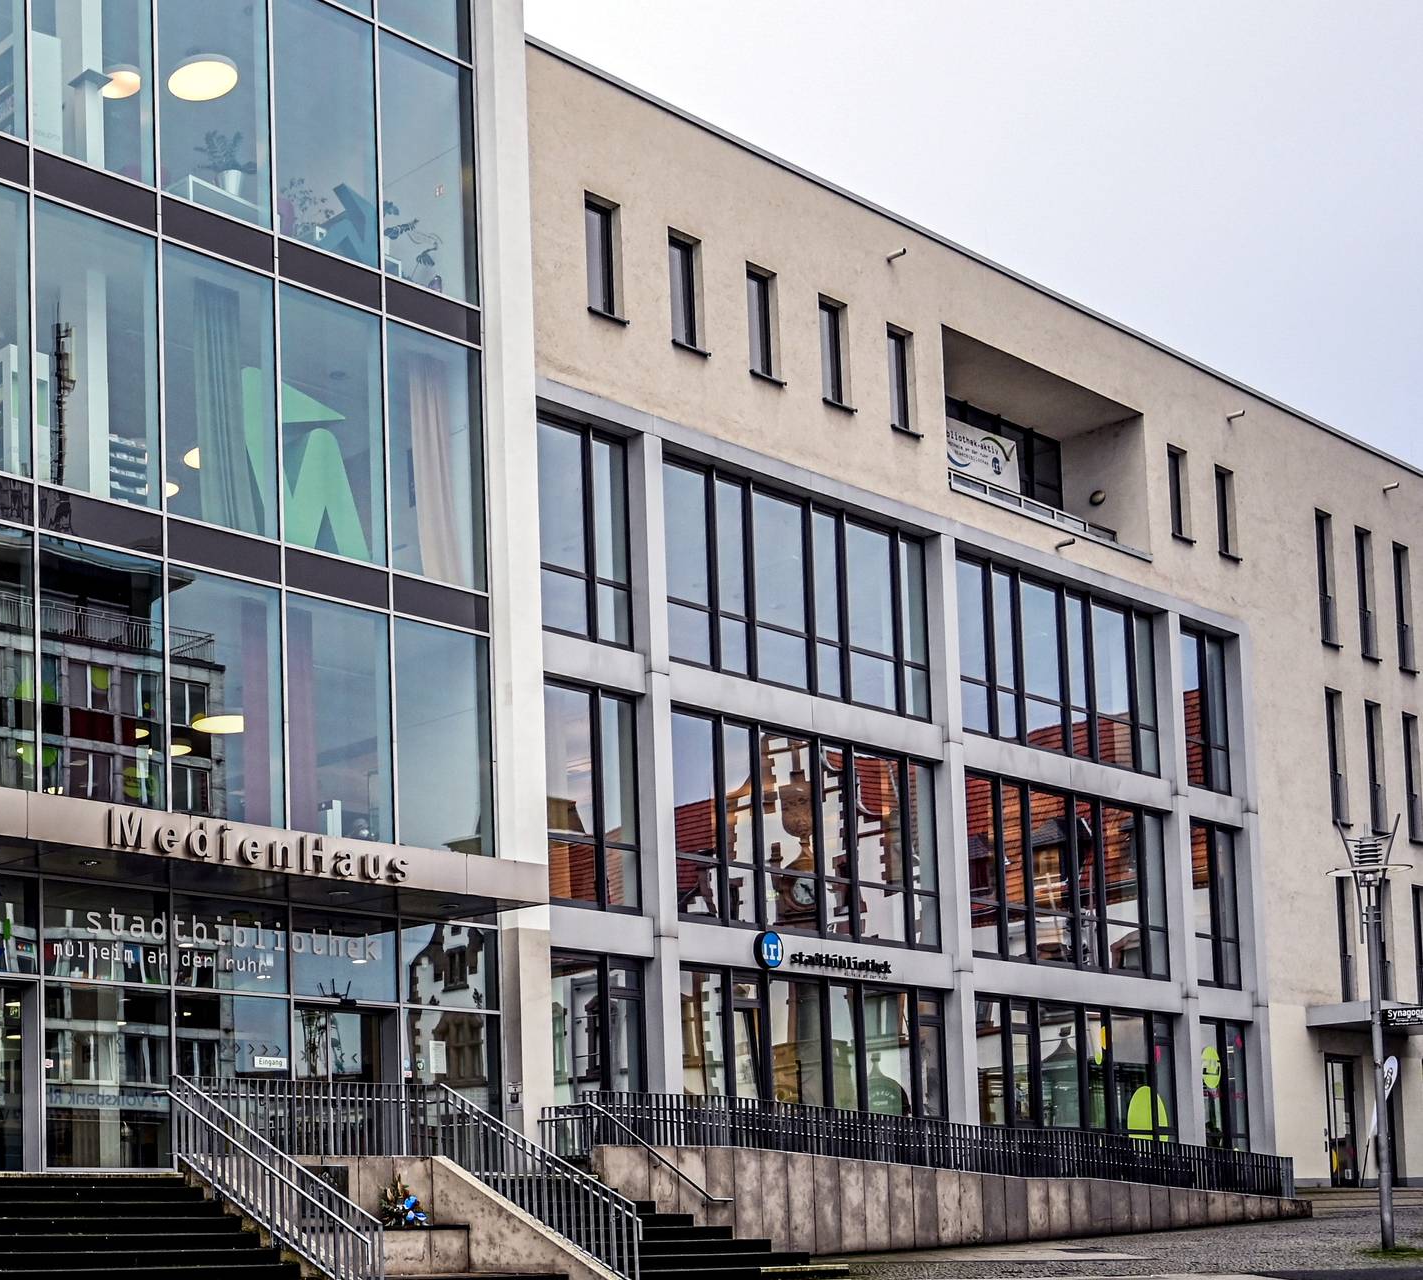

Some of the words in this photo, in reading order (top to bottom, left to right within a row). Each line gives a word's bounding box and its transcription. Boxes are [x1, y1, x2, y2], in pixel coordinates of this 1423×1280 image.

[108, 806, 410, 883] MedienHaus
[86, 907, 380, 960] stadtbibliothek
[53, 940, 134, 963] mülheim
[148, 951, 169, 966] an
[182, 948, 212, 968] der
[225, 956, 268, 973] ruhr
[790, 951, 892, 974] stadtbibliothek
[258, 1057, 283, 1068] Eingang
